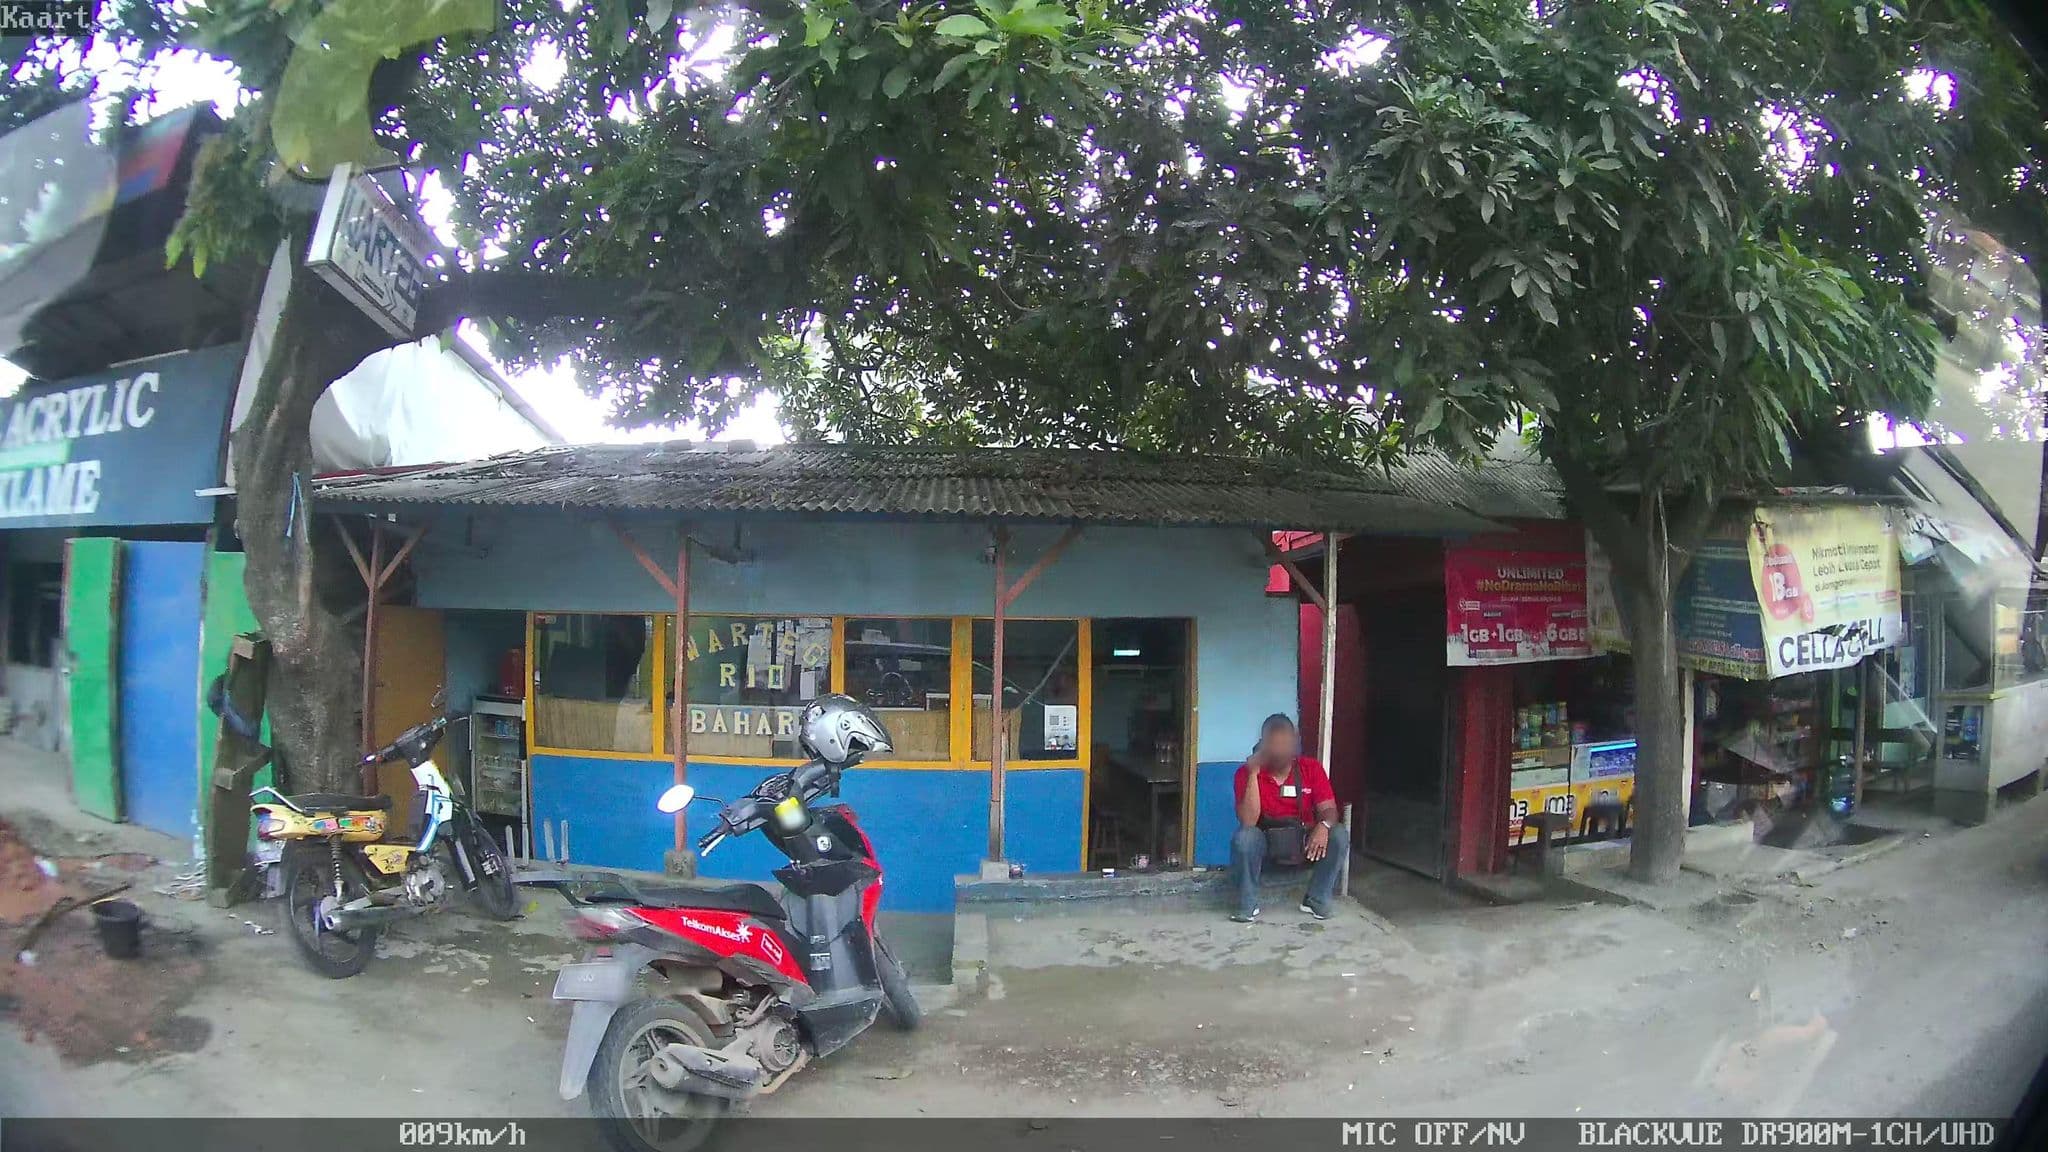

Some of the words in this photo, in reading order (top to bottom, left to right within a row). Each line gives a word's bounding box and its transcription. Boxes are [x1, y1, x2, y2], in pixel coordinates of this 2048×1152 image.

[1, 371, 160, 448] ACRYLIC
[1497, 567, 1564, 580] UNLIMITED
[719, 662, 785, 689] RIO
[680, 916, 743, 942] TelkomAkses
